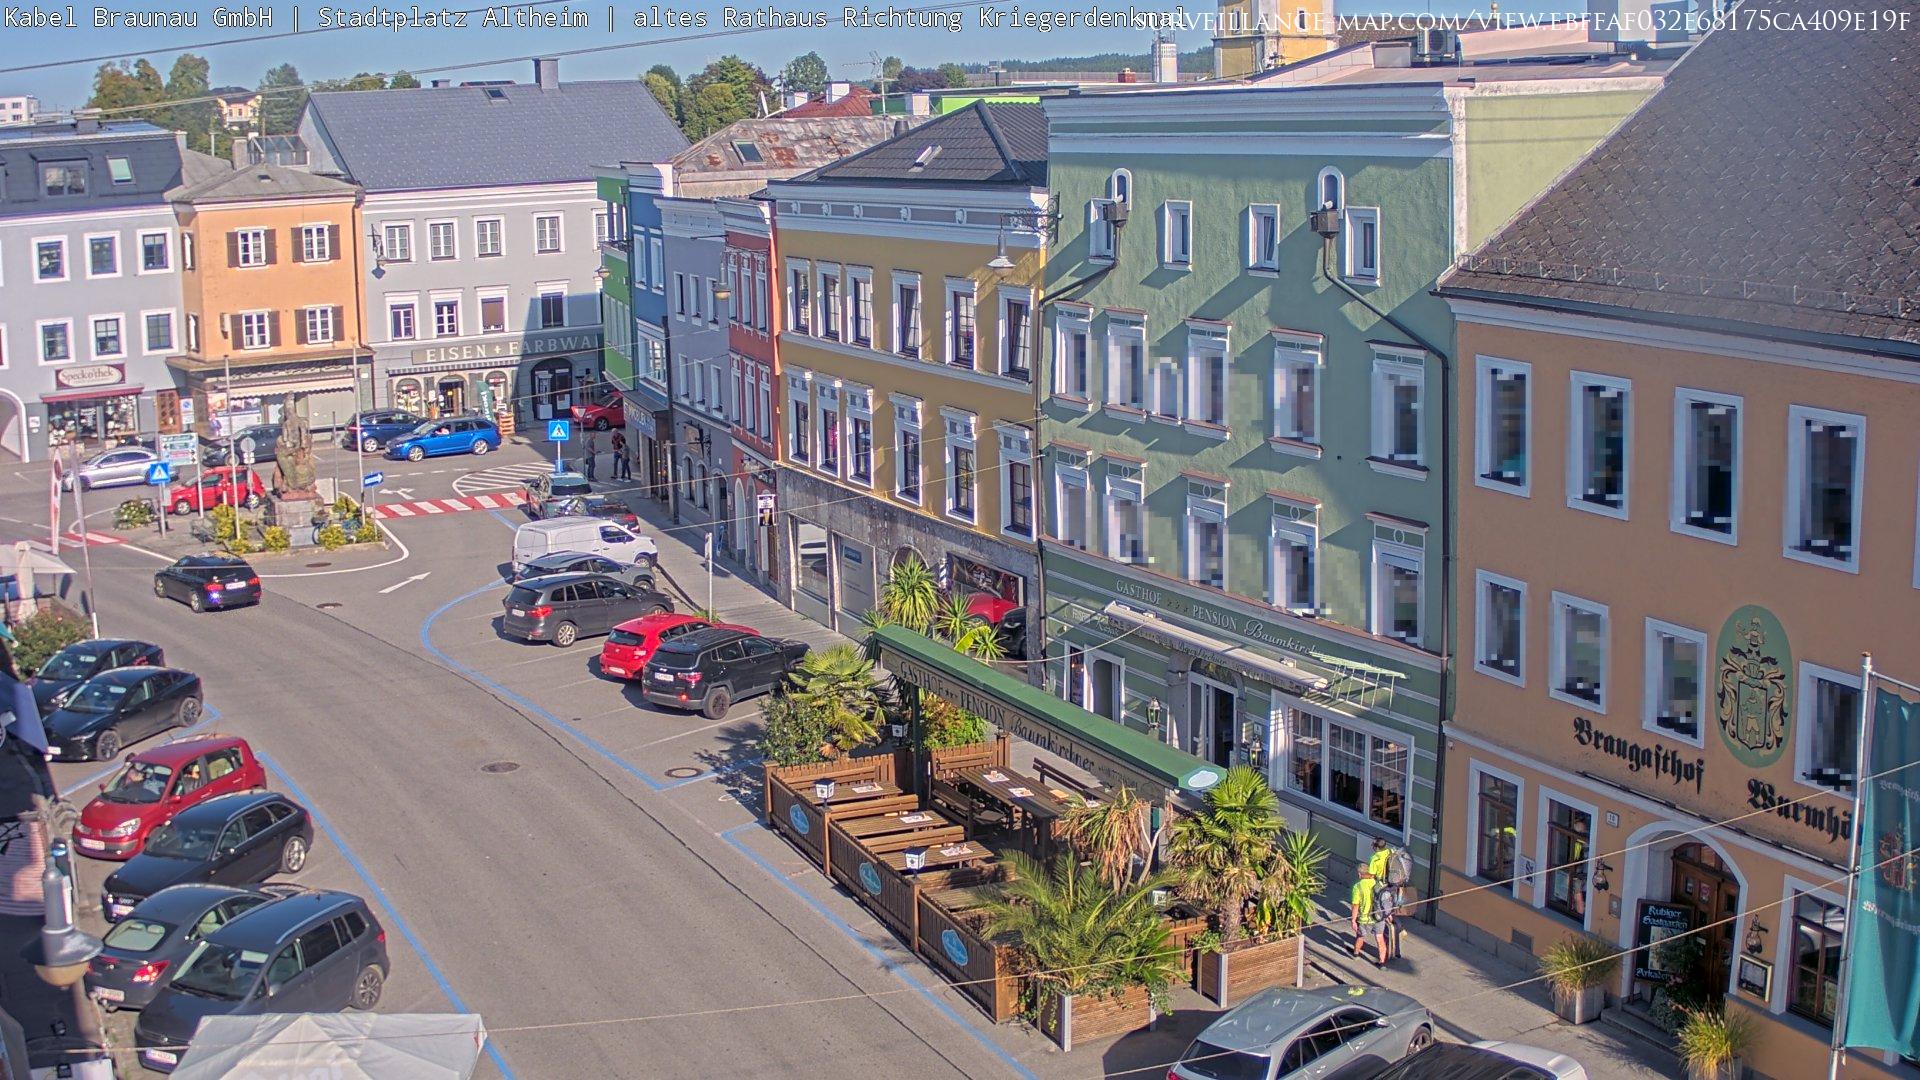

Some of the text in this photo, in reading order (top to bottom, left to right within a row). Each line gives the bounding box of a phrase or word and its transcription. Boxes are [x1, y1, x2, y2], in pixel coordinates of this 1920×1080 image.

[425, 343, 486, 363] EISEN
[1116, 580, 1162, 606] GASTHOF
[1192, 604, 1238, 631] PENSION
[900, 661, 1095, 773] GASTHOF PENSION Baumkirchner
